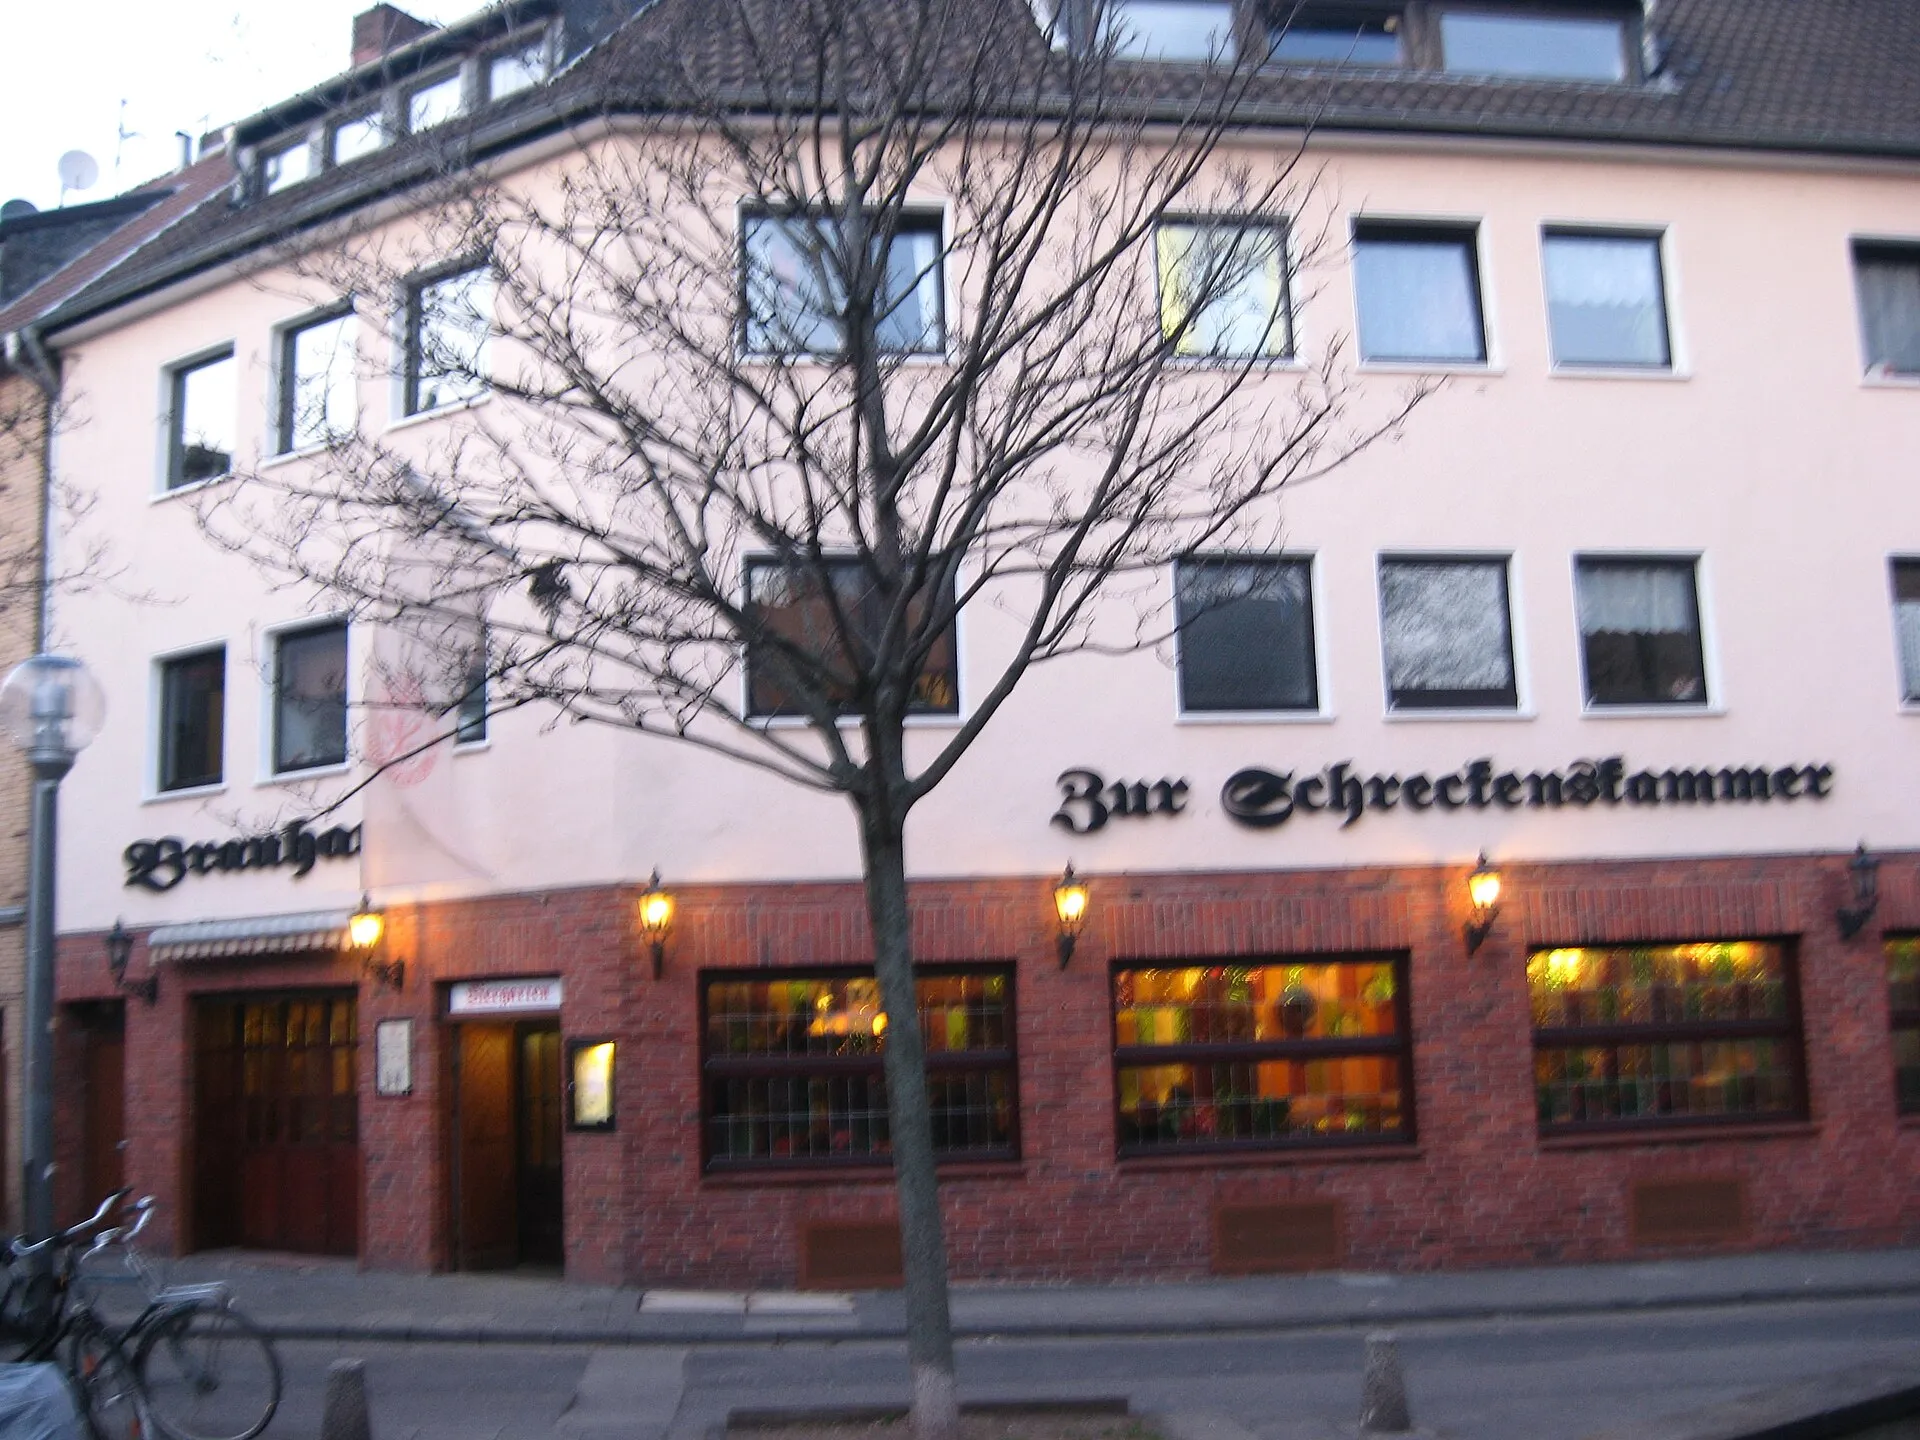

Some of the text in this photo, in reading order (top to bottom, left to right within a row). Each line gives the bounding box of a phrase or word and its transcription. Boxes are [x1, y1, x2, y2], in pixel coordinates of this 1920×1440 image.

[1051, 755, 1834, 833] Zur Schreckenskammer
[124, 816, 362, 890] Brauha
